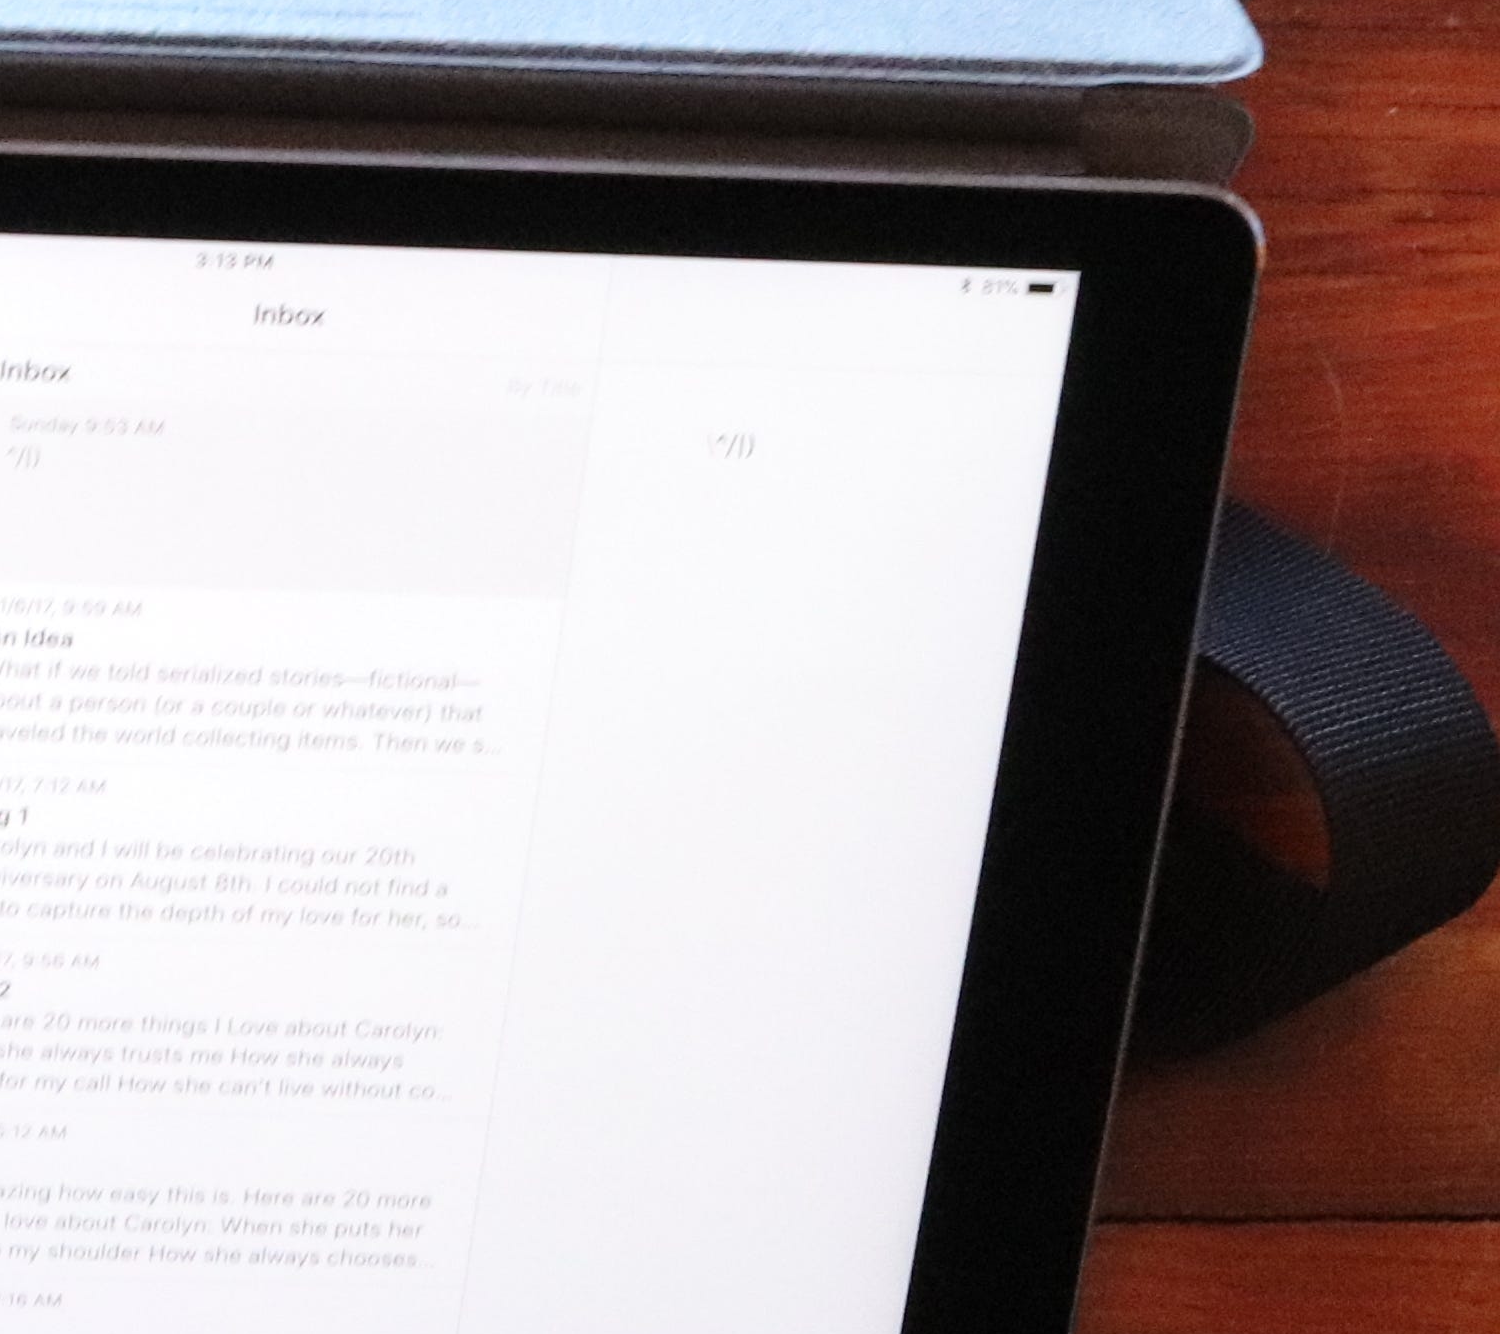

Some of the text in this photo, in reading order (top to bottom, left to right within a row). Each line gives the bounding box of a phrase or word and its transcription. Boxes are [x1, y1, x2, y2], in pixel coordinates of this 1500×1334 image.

[253, 303, 326, 326] Inbox
[0, 359, 71, 382] Inbox
[24, 628, 74, 648] Idea
[47, 659, 63, 680] if
[68, 664, 101, 682] we
[108, 662, 151, 683] told
[157, 664, 264, 686] serialized
[49, 695, 63, 712] a
[68, 695, 147, 716] person
[154, 695, 185, 716] (or
[190, 699, 205, 716] a
[210, 697, 287, 721] couple
[292, 701, 317, 719] or
[321, 700, 433, 725] whatever)
[440, 703, 484, 723] that
[71, 723, 108, 744] the
[114, 724, 177, 746] world
[181, 726, 292, 754] collecting
[297, 729, 362, 751] items.
[373, 731, 429, 753] Then
[434, 737, 467, 755] we
[19, 806, 28, 825] 1
[52, 839, 96, 860] and
[113, 839, 150, 860] will
[155, 840, 184, 861] be
[190, 842, 316, 869] celebrating
[320, 849, 358, 866] our
[363, 845, 416, 867] 20th
[39, 1042, 115, 1067] always
[120, 1045, 184, 1065] trusts
[189, 1049, 224, 1066] me
[230, 1047, 280, 1068] How
[285, 1048, 325, 1068] she
[331, 1048, 404, 1074] always
[58, 1182, 105, 1203] how
[109, 1187, 160, 1209] easy
[166, 1185, 206, 1205] this
[242, 1188, 295, 1208] Here
[300, 1191, 337, 1208] are
[342, 1188, 371, 1210] 20
[376, 1193, 433, 1210] more
